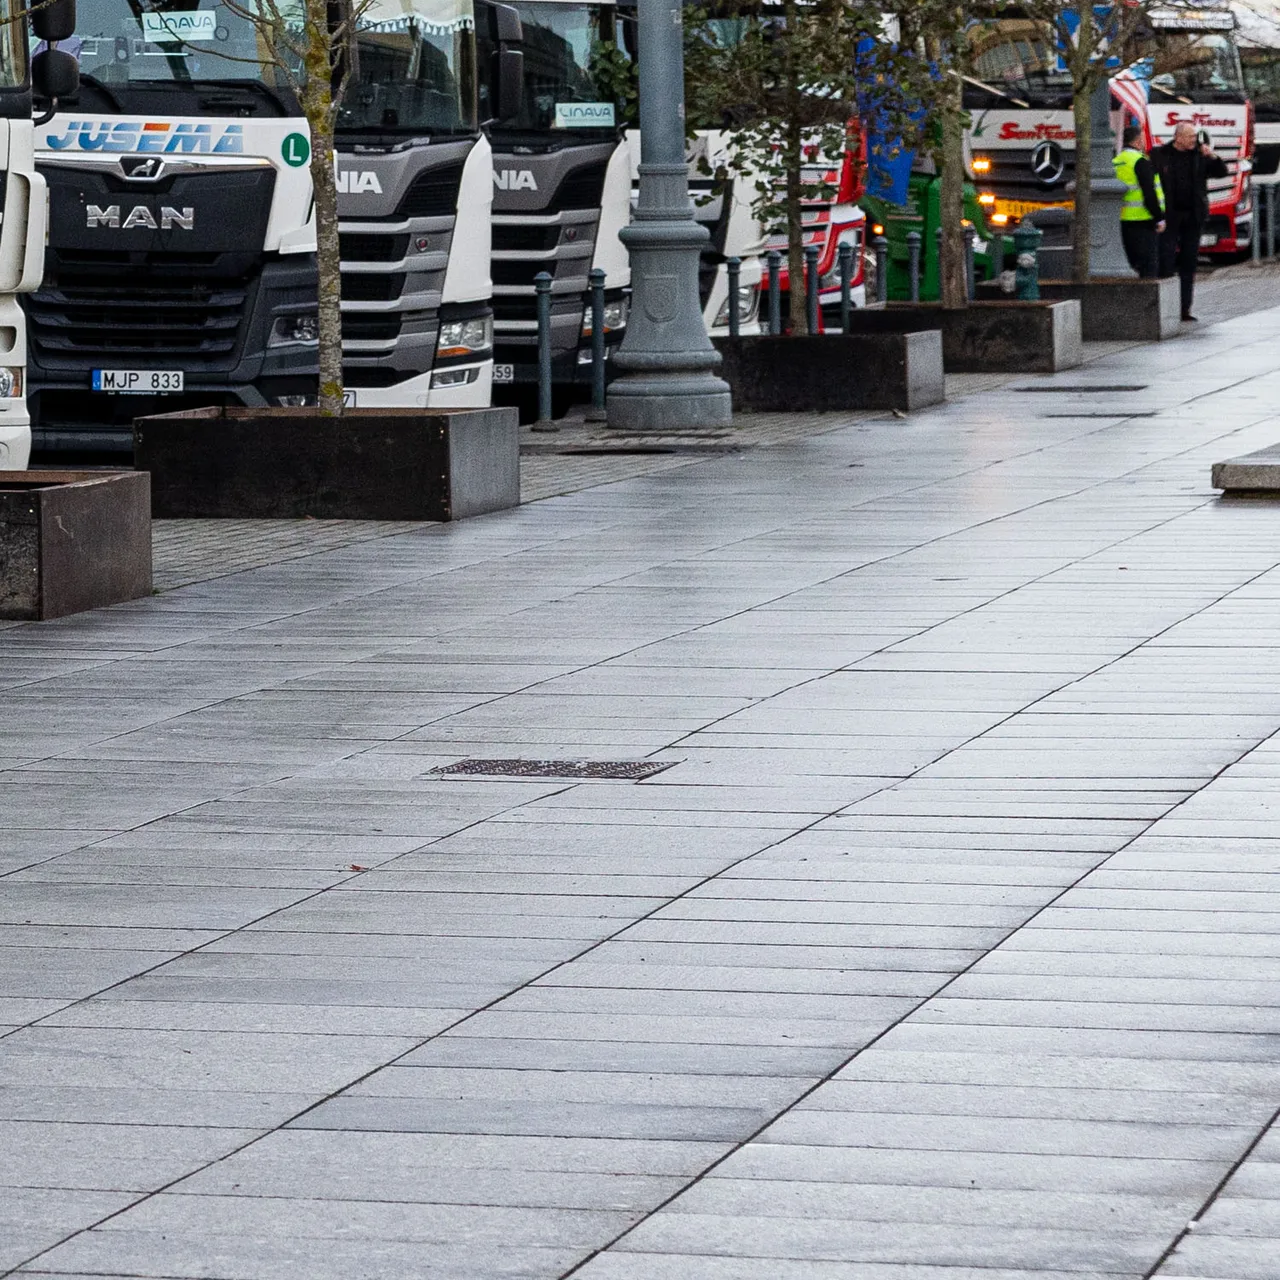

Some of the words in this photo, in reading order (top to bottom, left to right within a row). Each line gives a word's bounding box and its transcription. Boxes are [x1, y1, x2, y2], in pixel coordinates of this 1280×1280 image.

[559, 107, 611, 118] LINAVA
[46, 121, 244, 153] JUSEMA
[288, 138, 302, 161] L
[336, 171, 383, 194] NIA
[492, 170, 538, 191] NIA
[86, 205, 194, 230] MAN
[103, 372, 139, 388] MJP
[151, 373, 180, 389] 833
